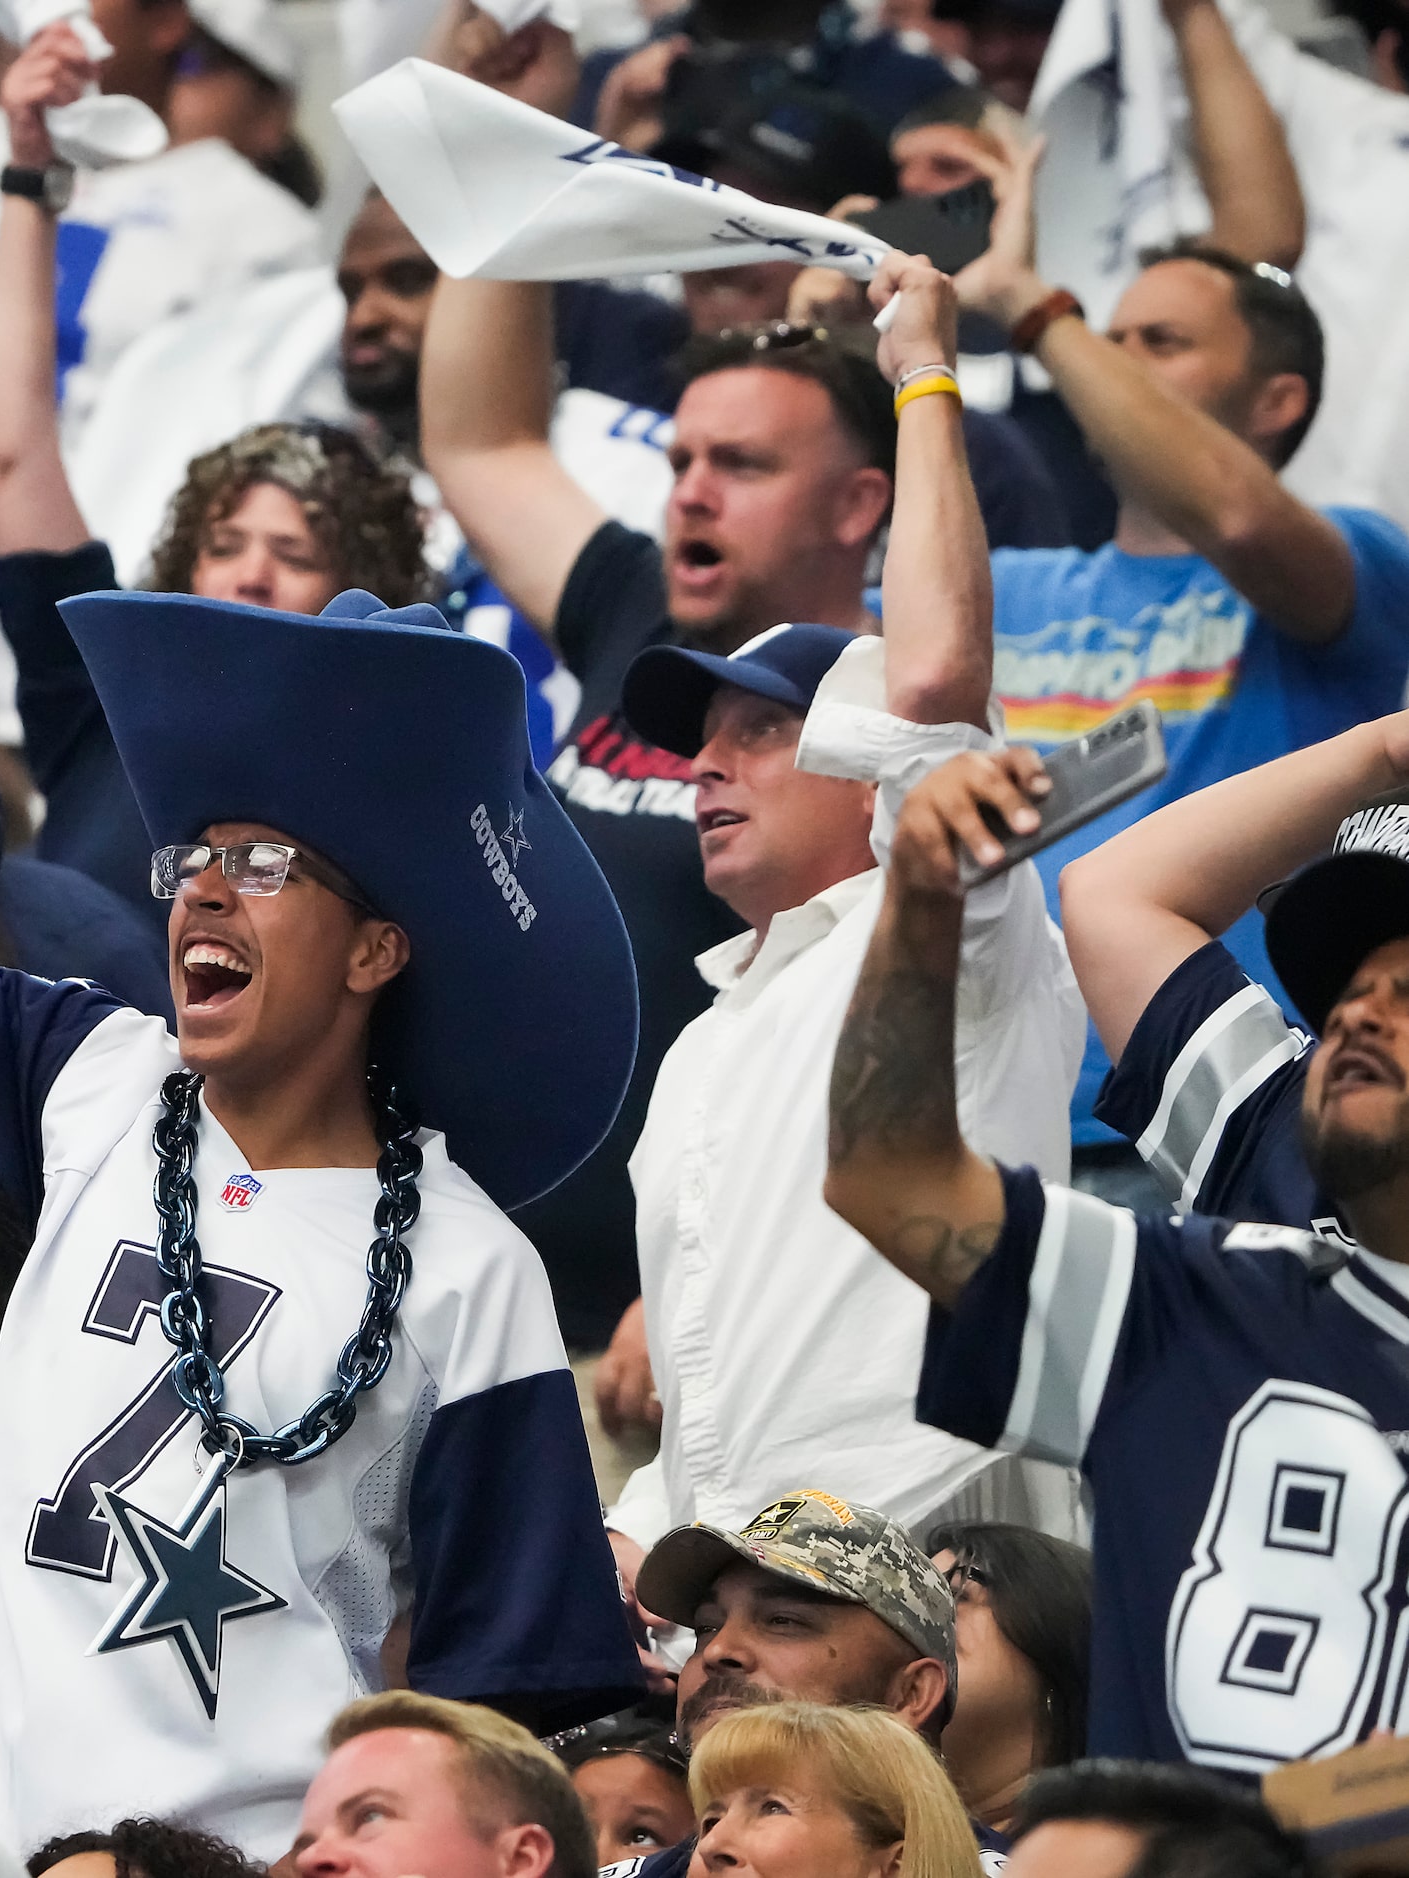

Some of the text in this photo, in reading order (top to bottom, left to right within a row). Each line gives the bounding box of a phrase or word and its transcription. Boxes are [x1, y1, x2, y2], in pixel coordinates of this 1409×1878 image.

[470, 803, 538, 932] COWBOYS
[221, 1184, 251, 1207] NFL
[24, 1238, 284, 1583] 7
[1165, 1377, 1409, 1774] 8
